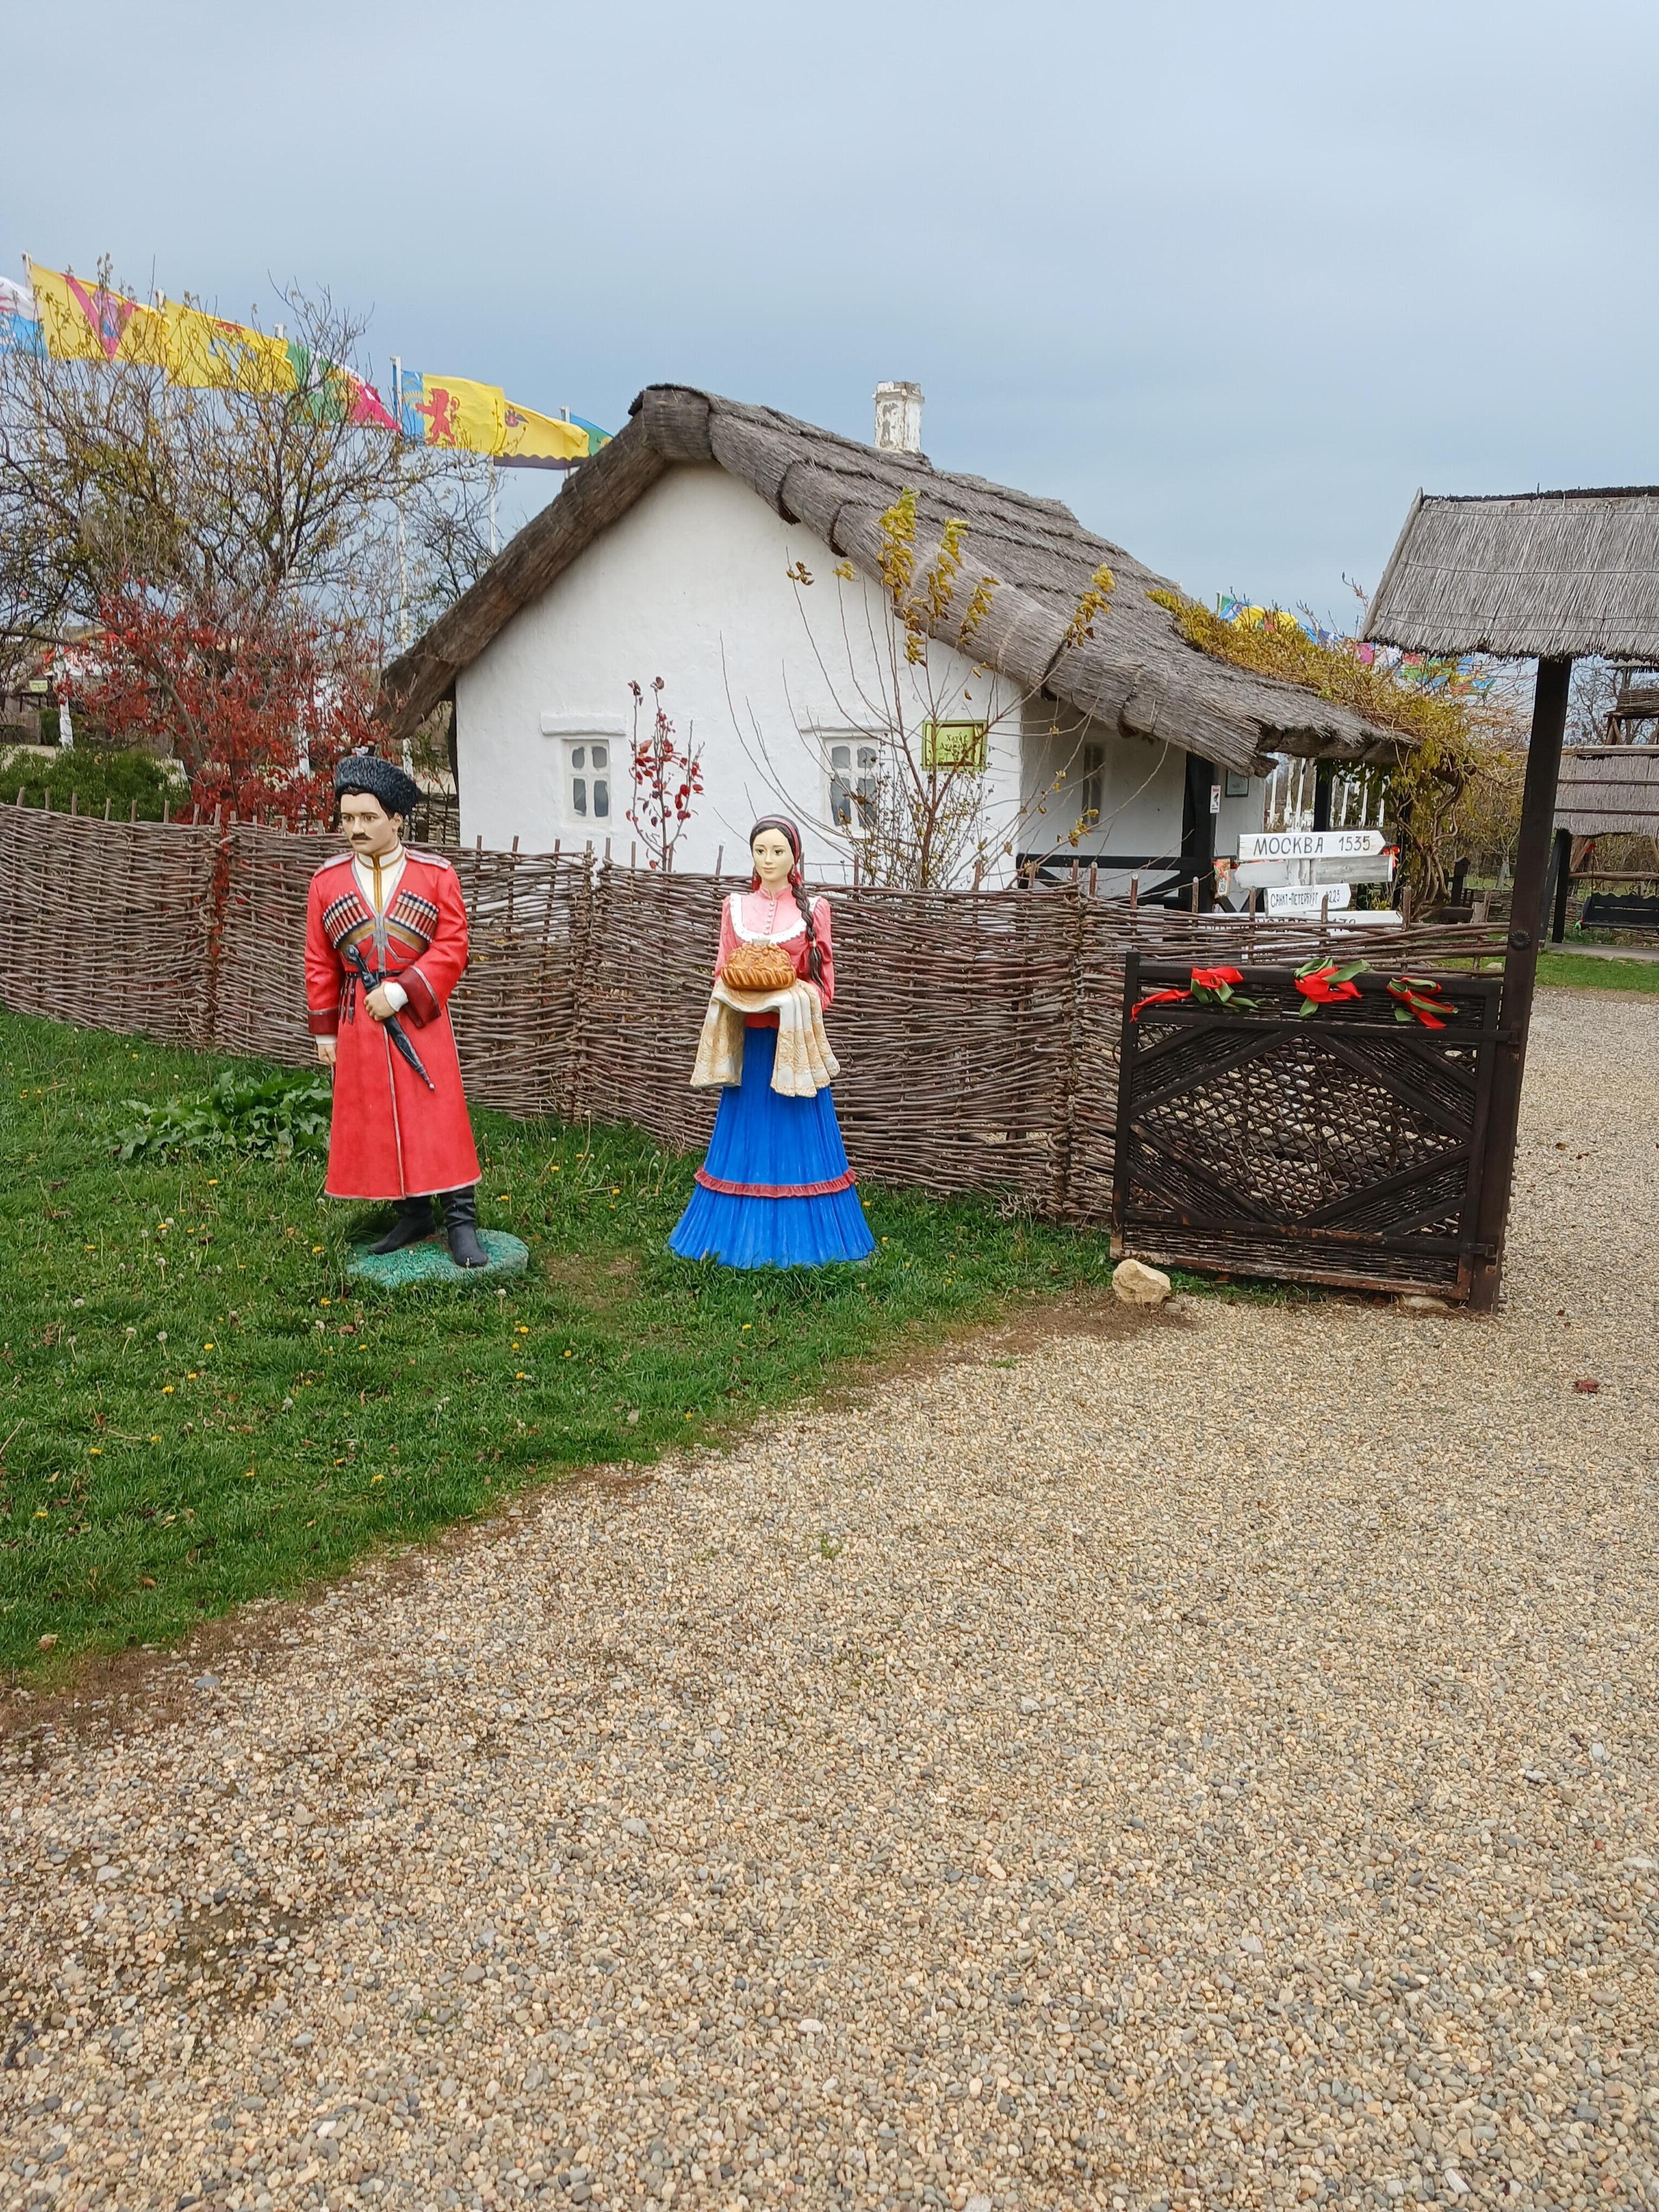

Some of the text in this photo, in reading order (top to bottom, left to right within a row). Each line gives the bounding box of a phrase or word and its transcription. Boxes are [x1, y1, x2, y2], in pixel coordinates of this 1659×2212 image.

[1253, 835, 1370, 856] МОСКВА 1535
[1270, 889, 1340, 908] САНКТ-ПЕТЕРБУРГ 225
